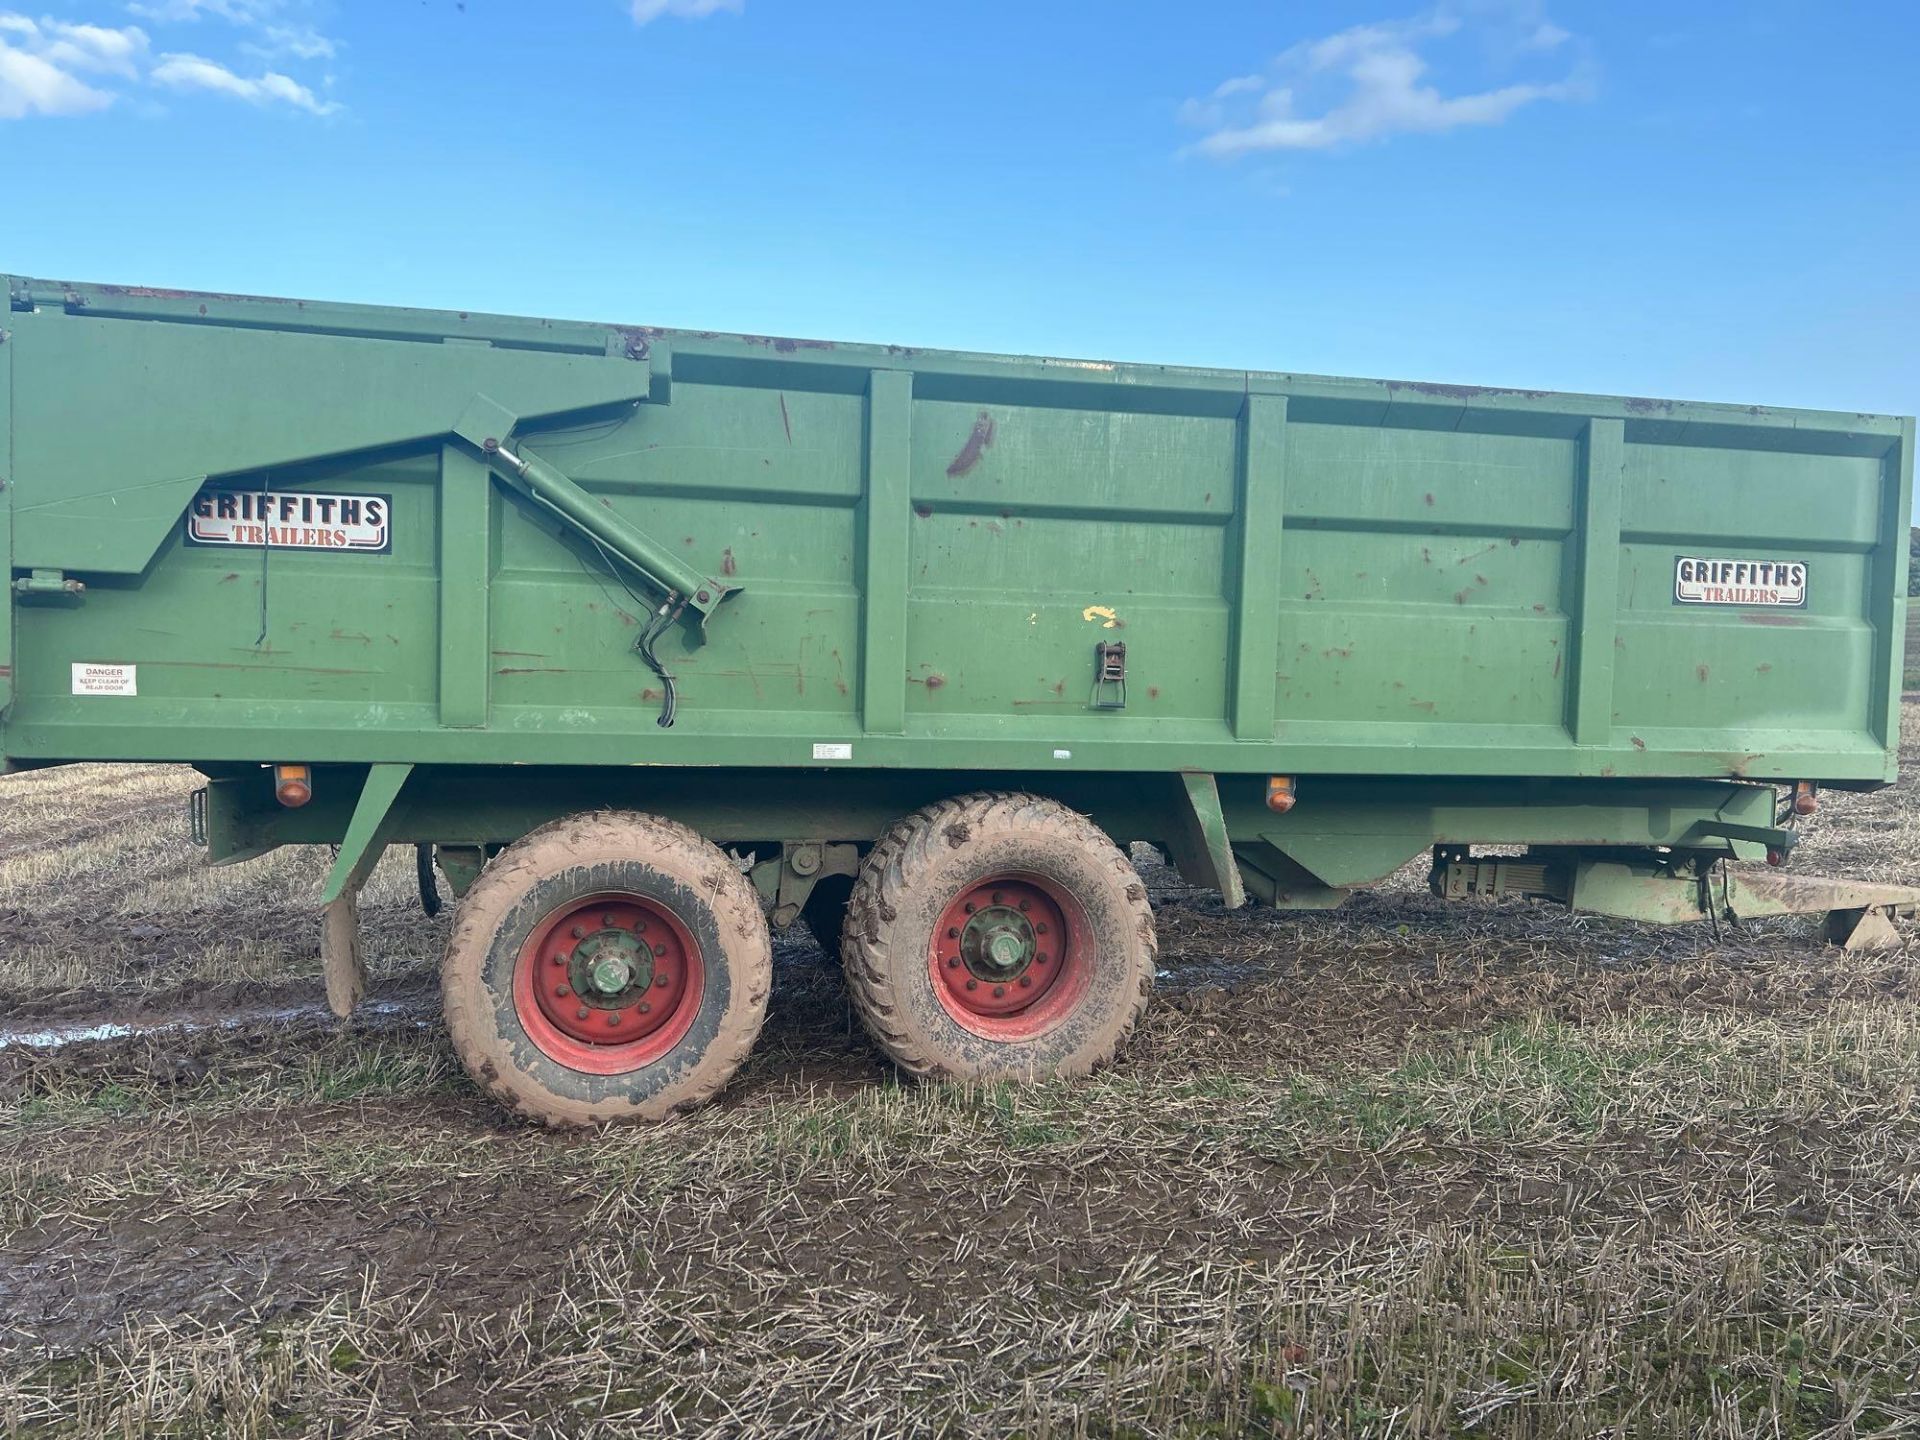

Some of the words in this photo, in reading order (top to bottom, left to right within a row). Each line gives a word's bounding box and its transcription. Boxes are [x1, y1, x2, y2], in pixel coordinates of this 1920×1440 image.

[194, 493, 383, 526] GRIFFITHS
[232, 524, 346, 546] TRAILERS
[1680, 560, 1803, 587] GRIFFITHS
[1704, 587, 1779, 603] TRAILERS
